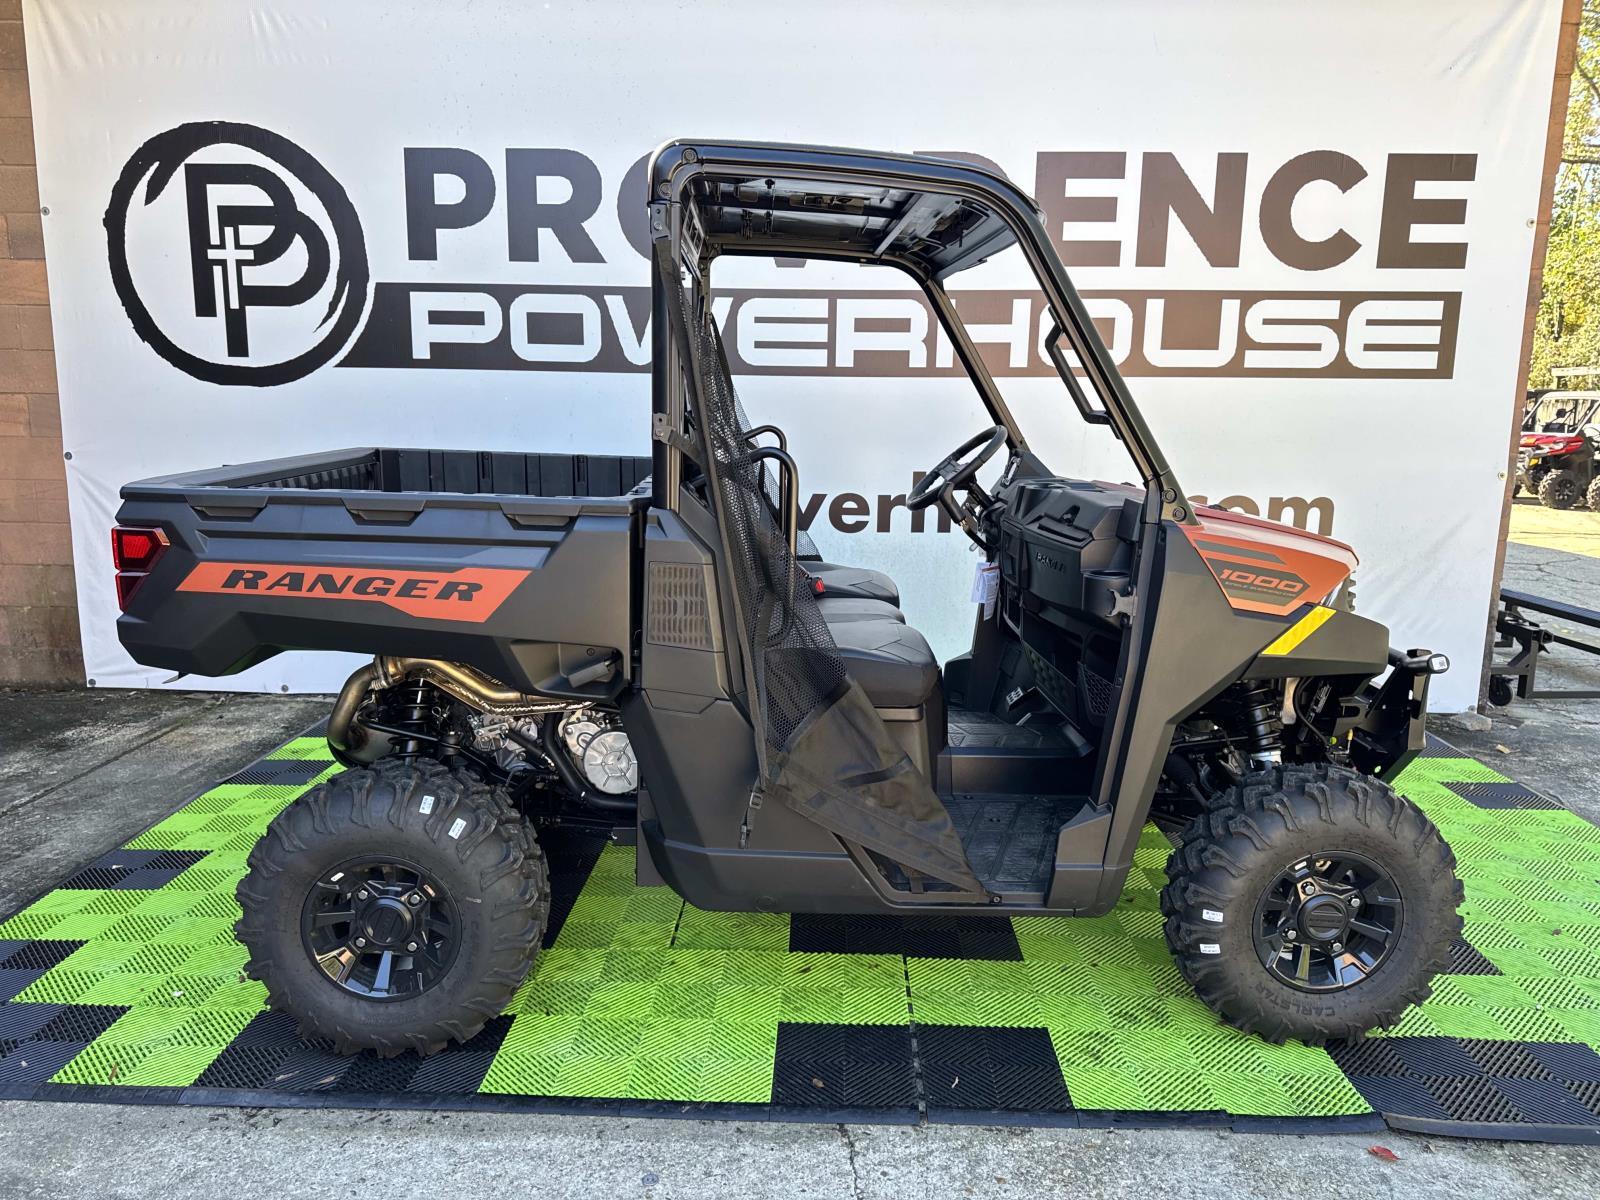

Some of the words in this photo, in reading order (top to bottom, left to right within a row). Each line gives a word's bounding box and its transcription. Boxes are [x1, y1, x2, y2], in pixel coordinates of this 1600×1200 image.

[403, 147, 1478, 272] PRENCE
[409, 291, 1445, 372] POWERHOUSE
[222, 569, 483, 602] RANGER
[1219, 568, 1303, 593] 1000
